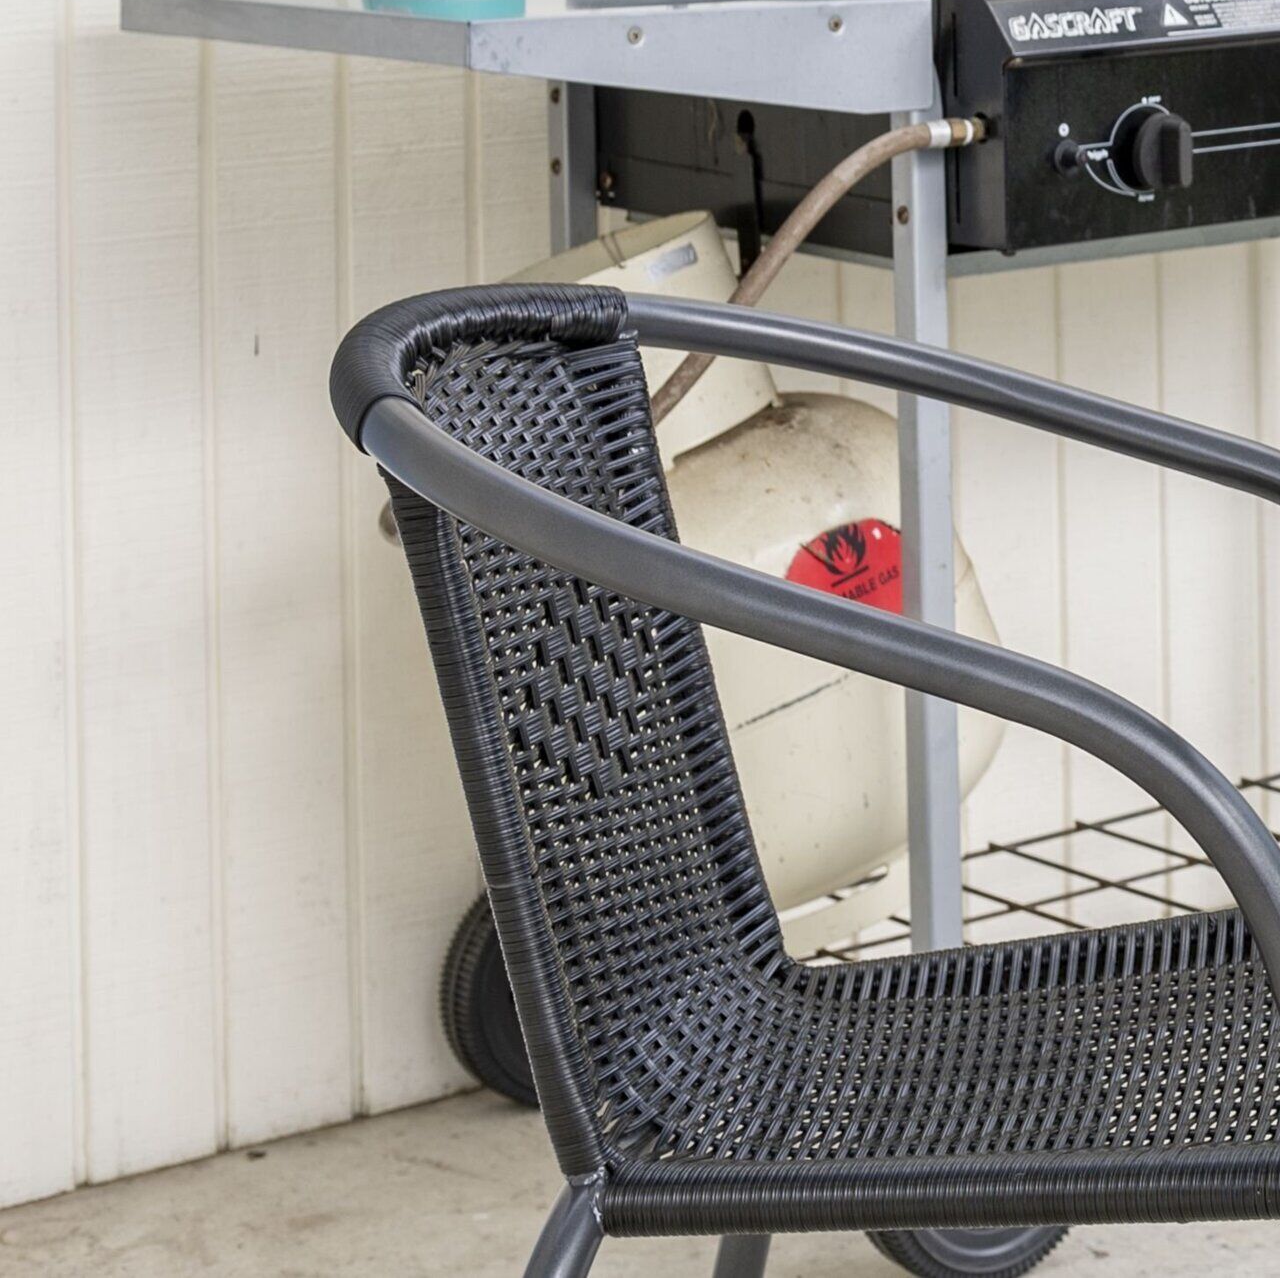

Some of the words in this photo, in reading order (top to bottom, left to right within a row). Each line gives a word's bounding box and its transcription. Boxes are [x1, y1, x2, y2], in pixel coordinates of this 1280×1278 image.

[1008, 6, 1138, 42] GASCRAFT
[842, 576, 878, 600] ABLE
[878, 564, 901, 586] GAS
